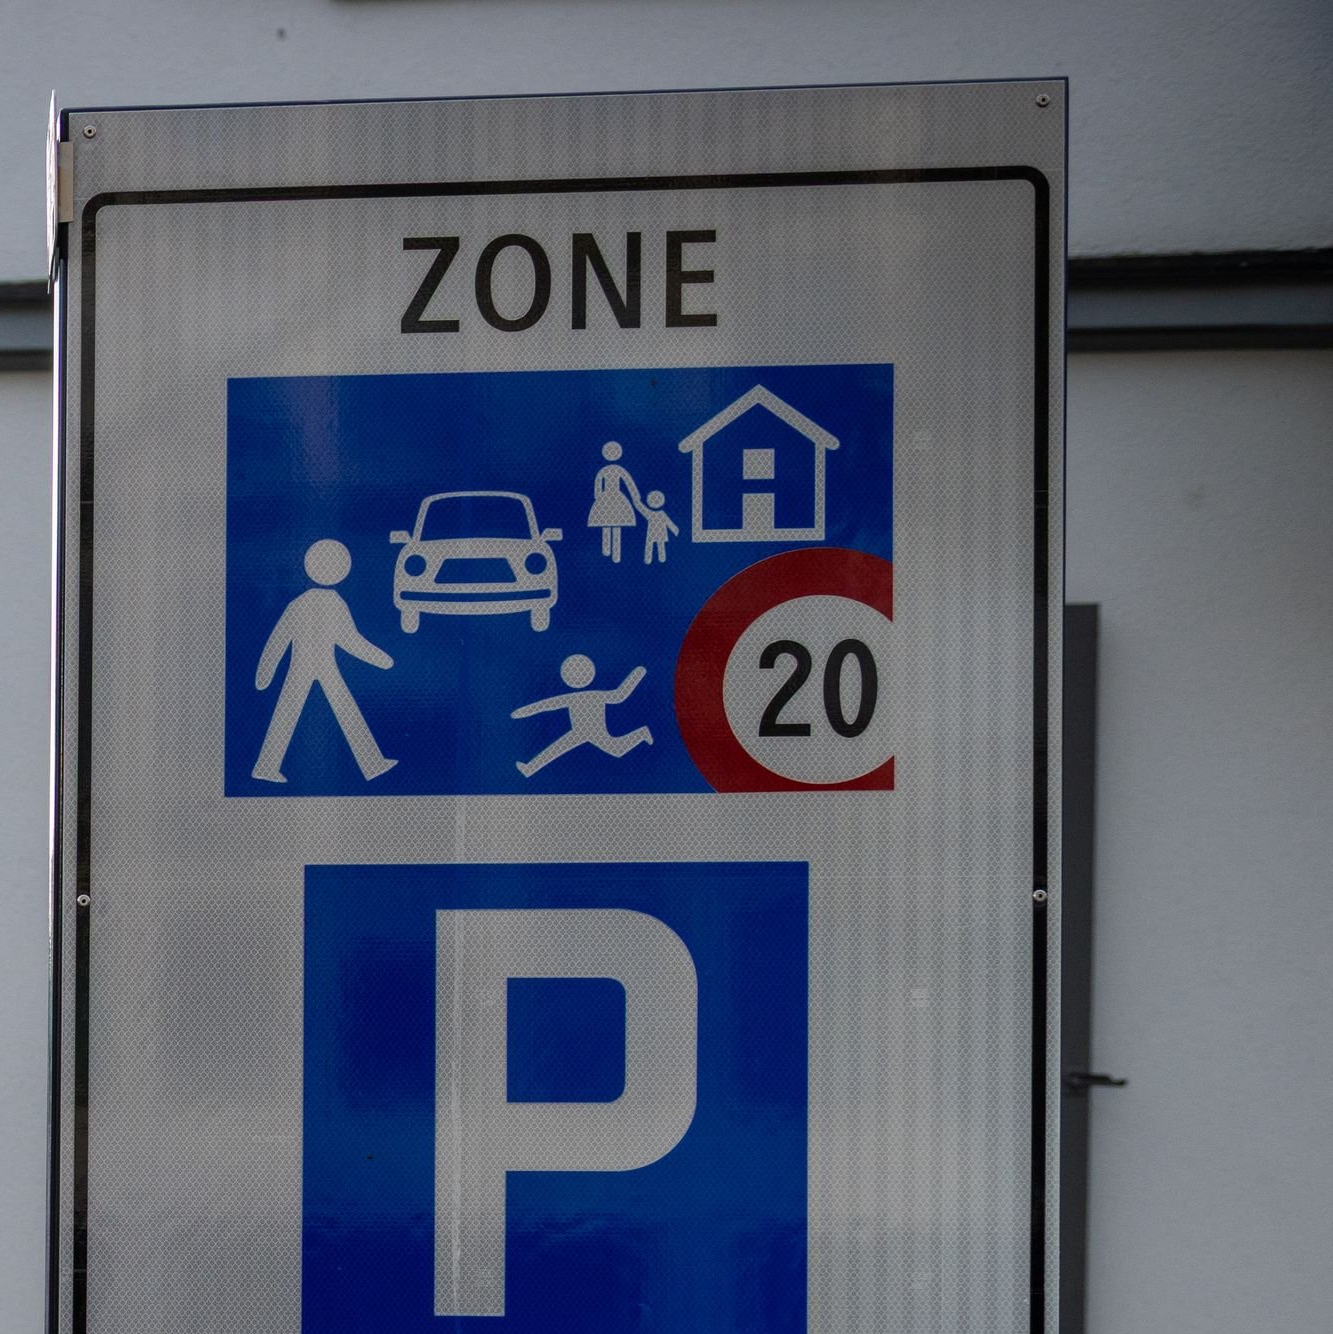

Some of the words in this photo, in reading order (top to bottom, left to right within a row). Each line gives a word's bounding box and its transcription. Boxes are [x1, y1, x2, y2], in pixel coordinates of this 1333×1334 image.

[400, 230, 719, 335] ZONE
[757, 637, 879, 739] 20
[433, 908, 699, 1317] P
